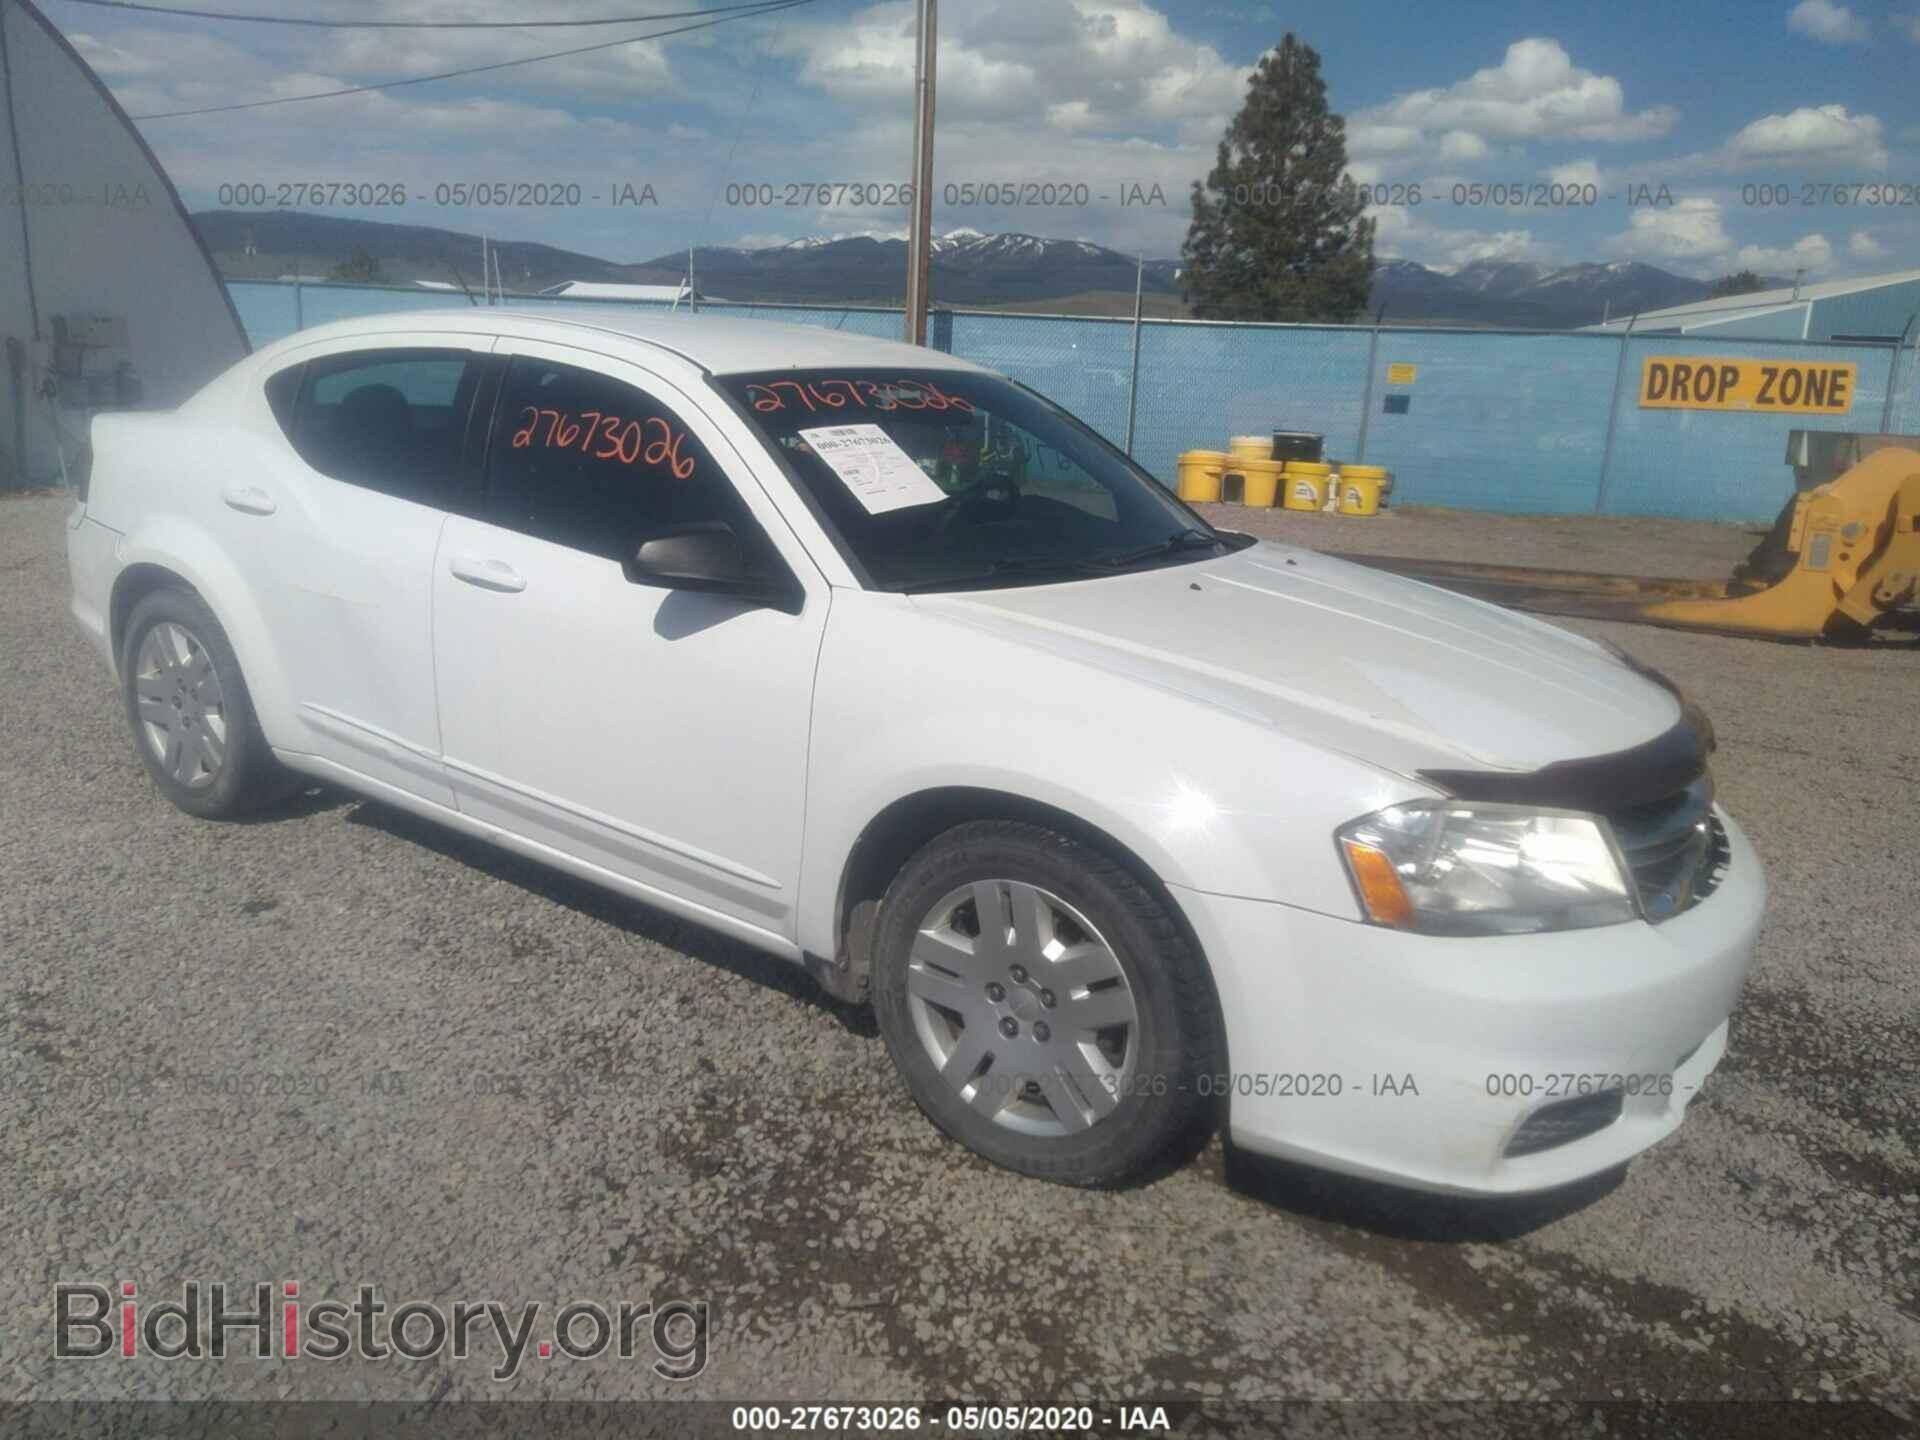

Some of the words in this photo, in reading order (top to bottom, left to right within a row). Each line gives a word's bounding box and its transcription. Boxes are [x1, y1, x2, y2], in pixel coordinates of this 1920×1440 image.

[1646, 363, 1741, 403] DROP
[1755, 366, 1850, 408] ZONE
[512, 406, 696, 480] 27673026
